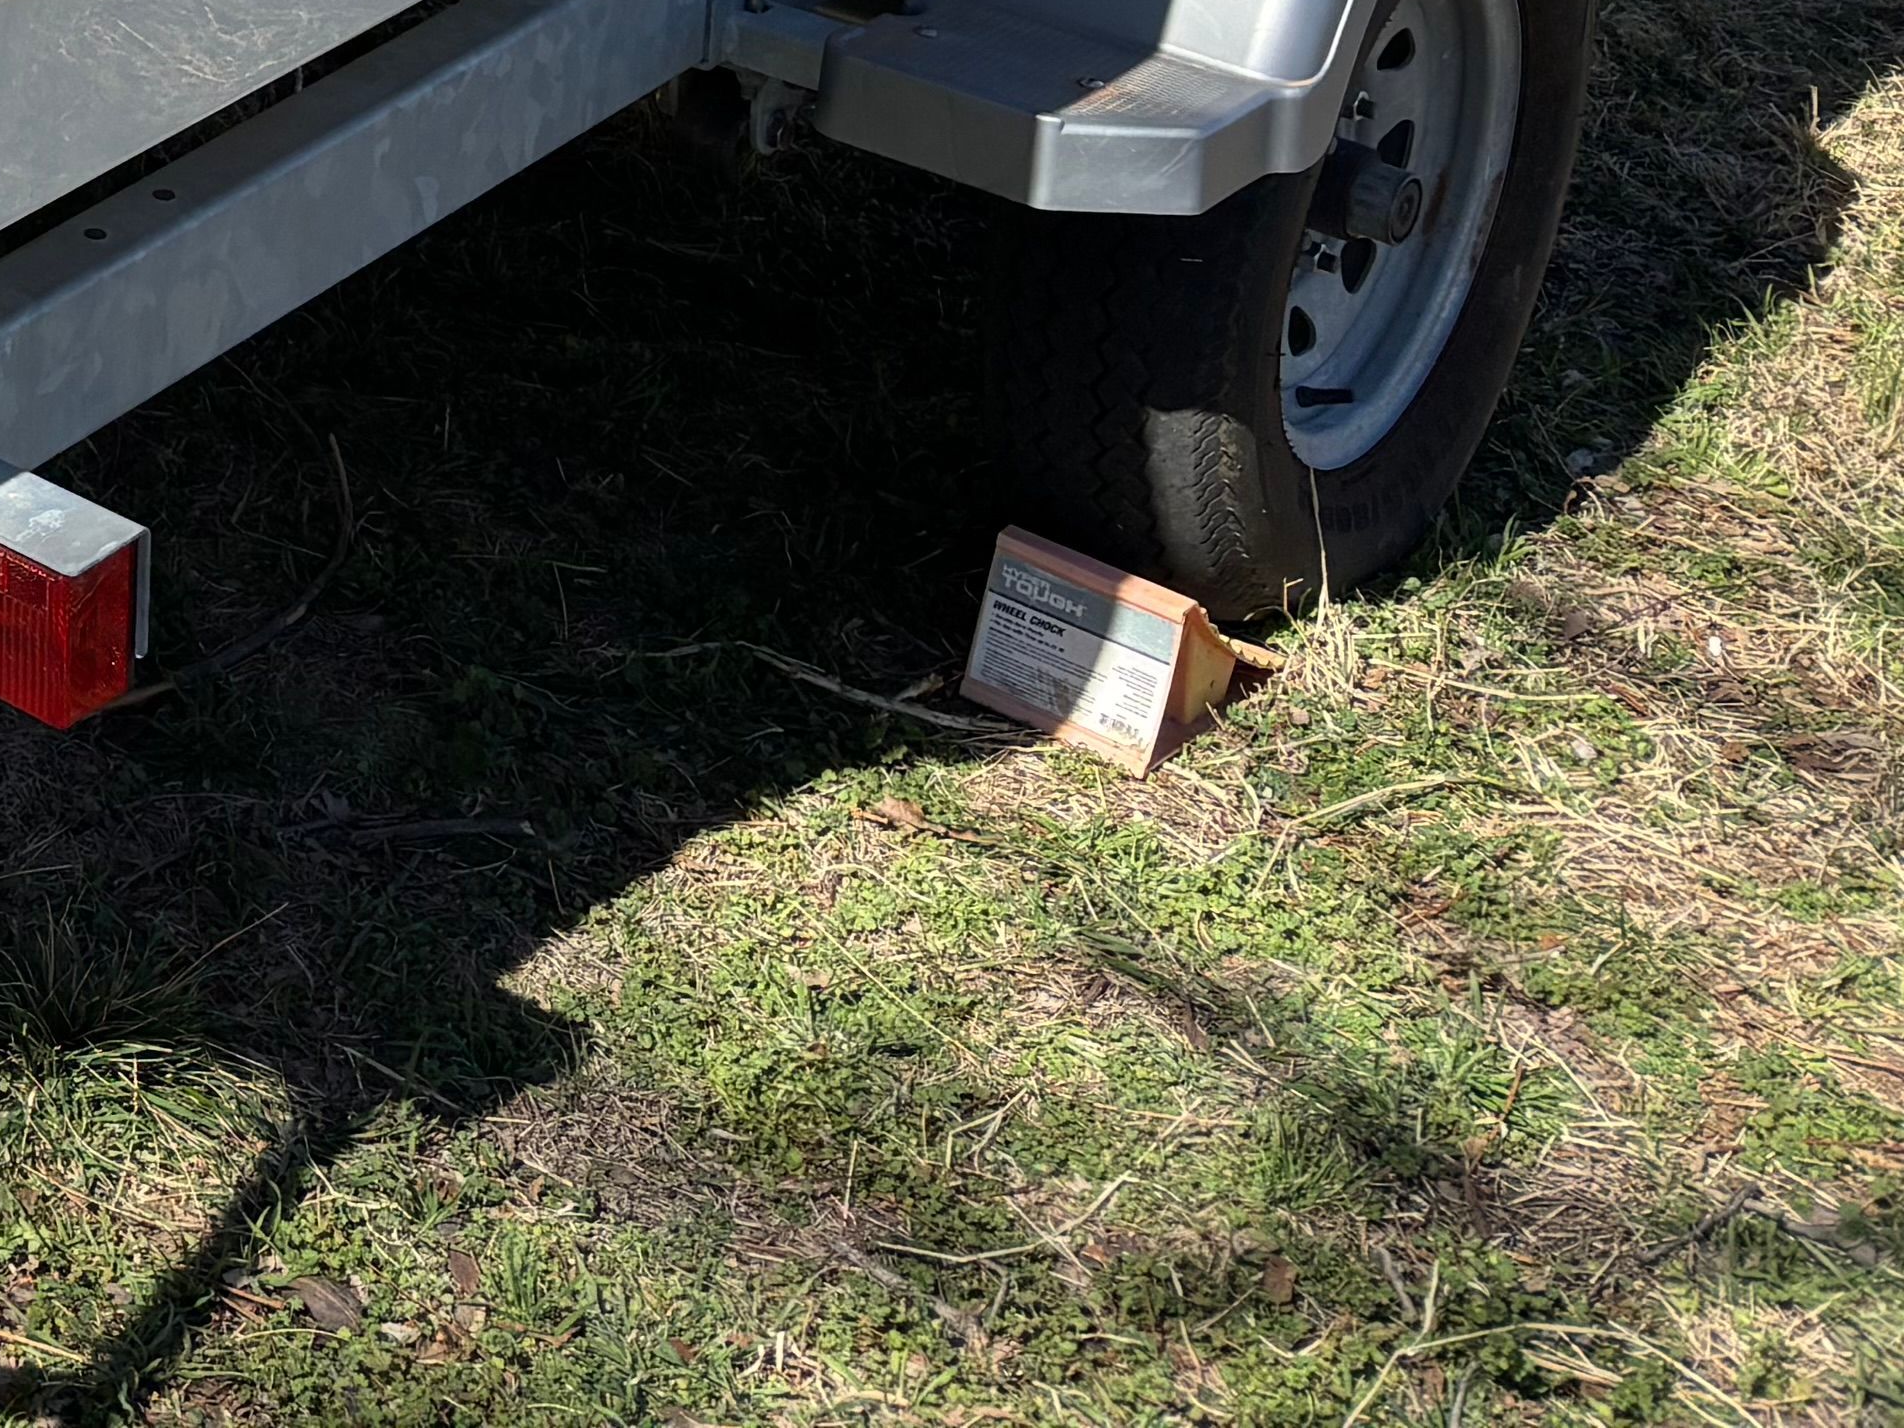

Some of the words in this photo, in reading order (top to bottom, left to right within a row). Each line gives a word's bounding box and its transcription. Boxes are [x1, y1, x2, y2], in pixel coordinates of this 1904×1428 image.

[1003, 575, 1084, 618] TOUGH
[993, 600, 1027, 621] WHEEL
[1030, 616, 1066, 638] CHOCK
